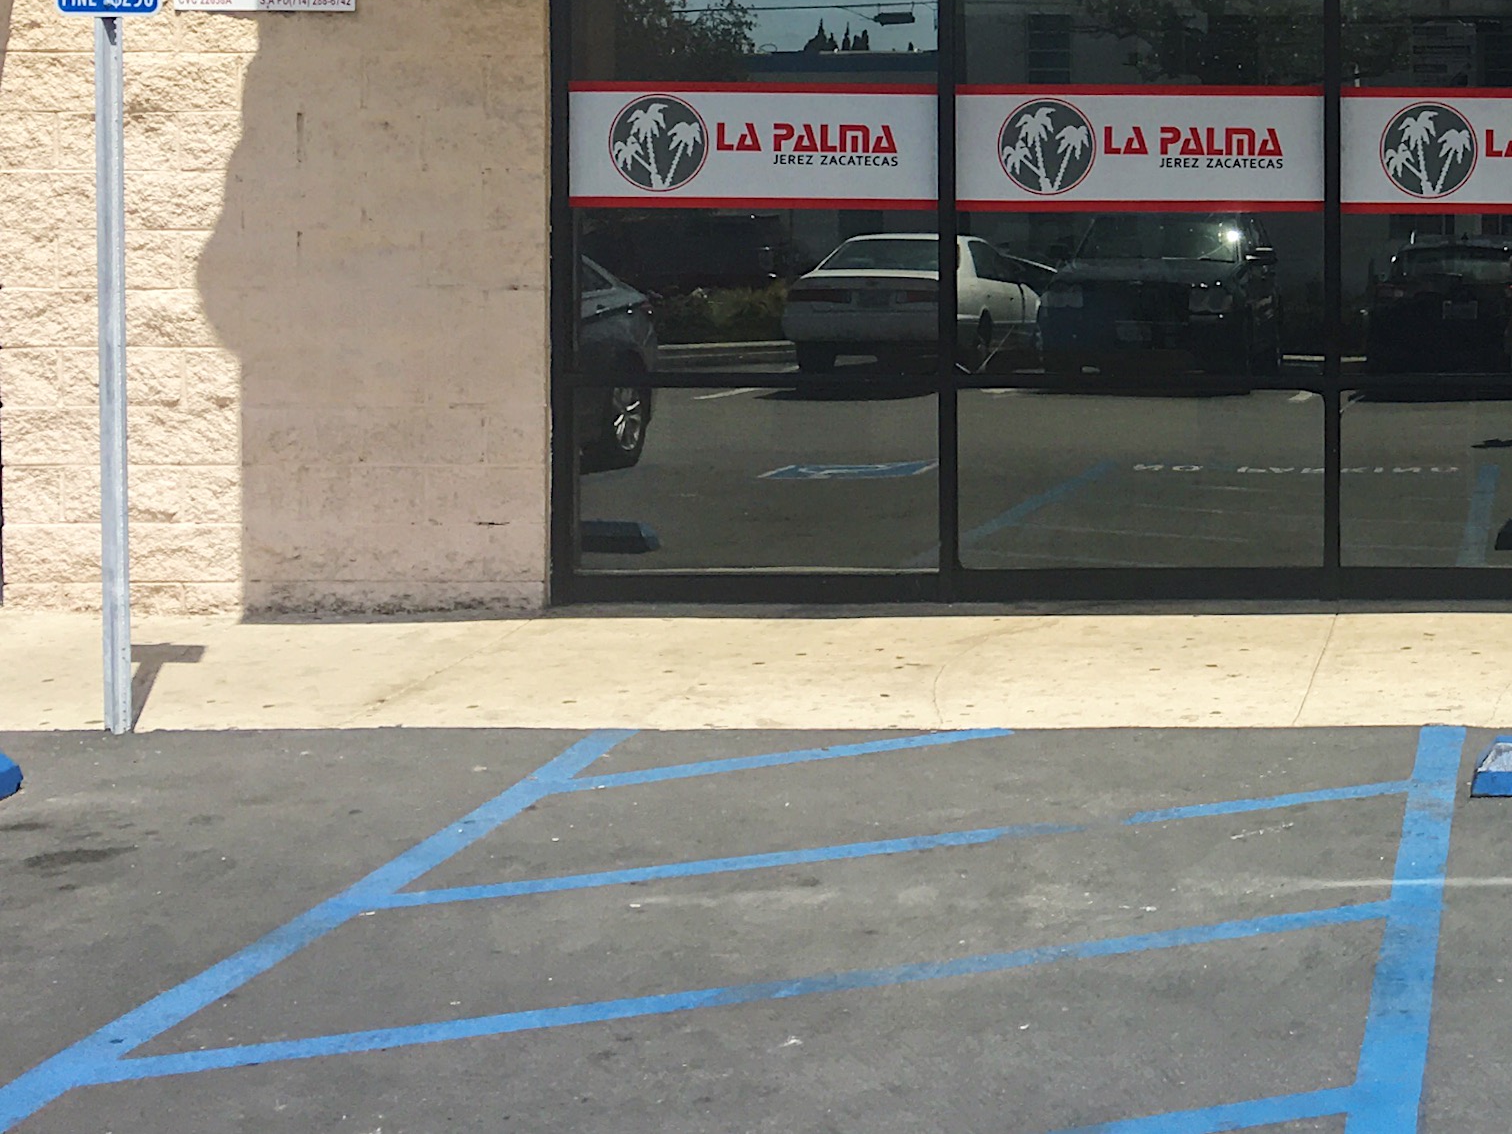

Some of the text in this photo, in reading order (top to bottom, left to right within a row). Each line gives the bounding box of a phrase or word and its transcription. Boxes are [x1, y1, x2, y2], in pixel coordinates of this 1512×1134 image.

[716, 122, 898, 153] LA PALMA
[1104, 126, 1284, 156] LA PALMA
[773, 154, 899, 167] JEREZ ZACATECAS
[1159, 158, 1285, 169] JEREZ ZACATECAS
